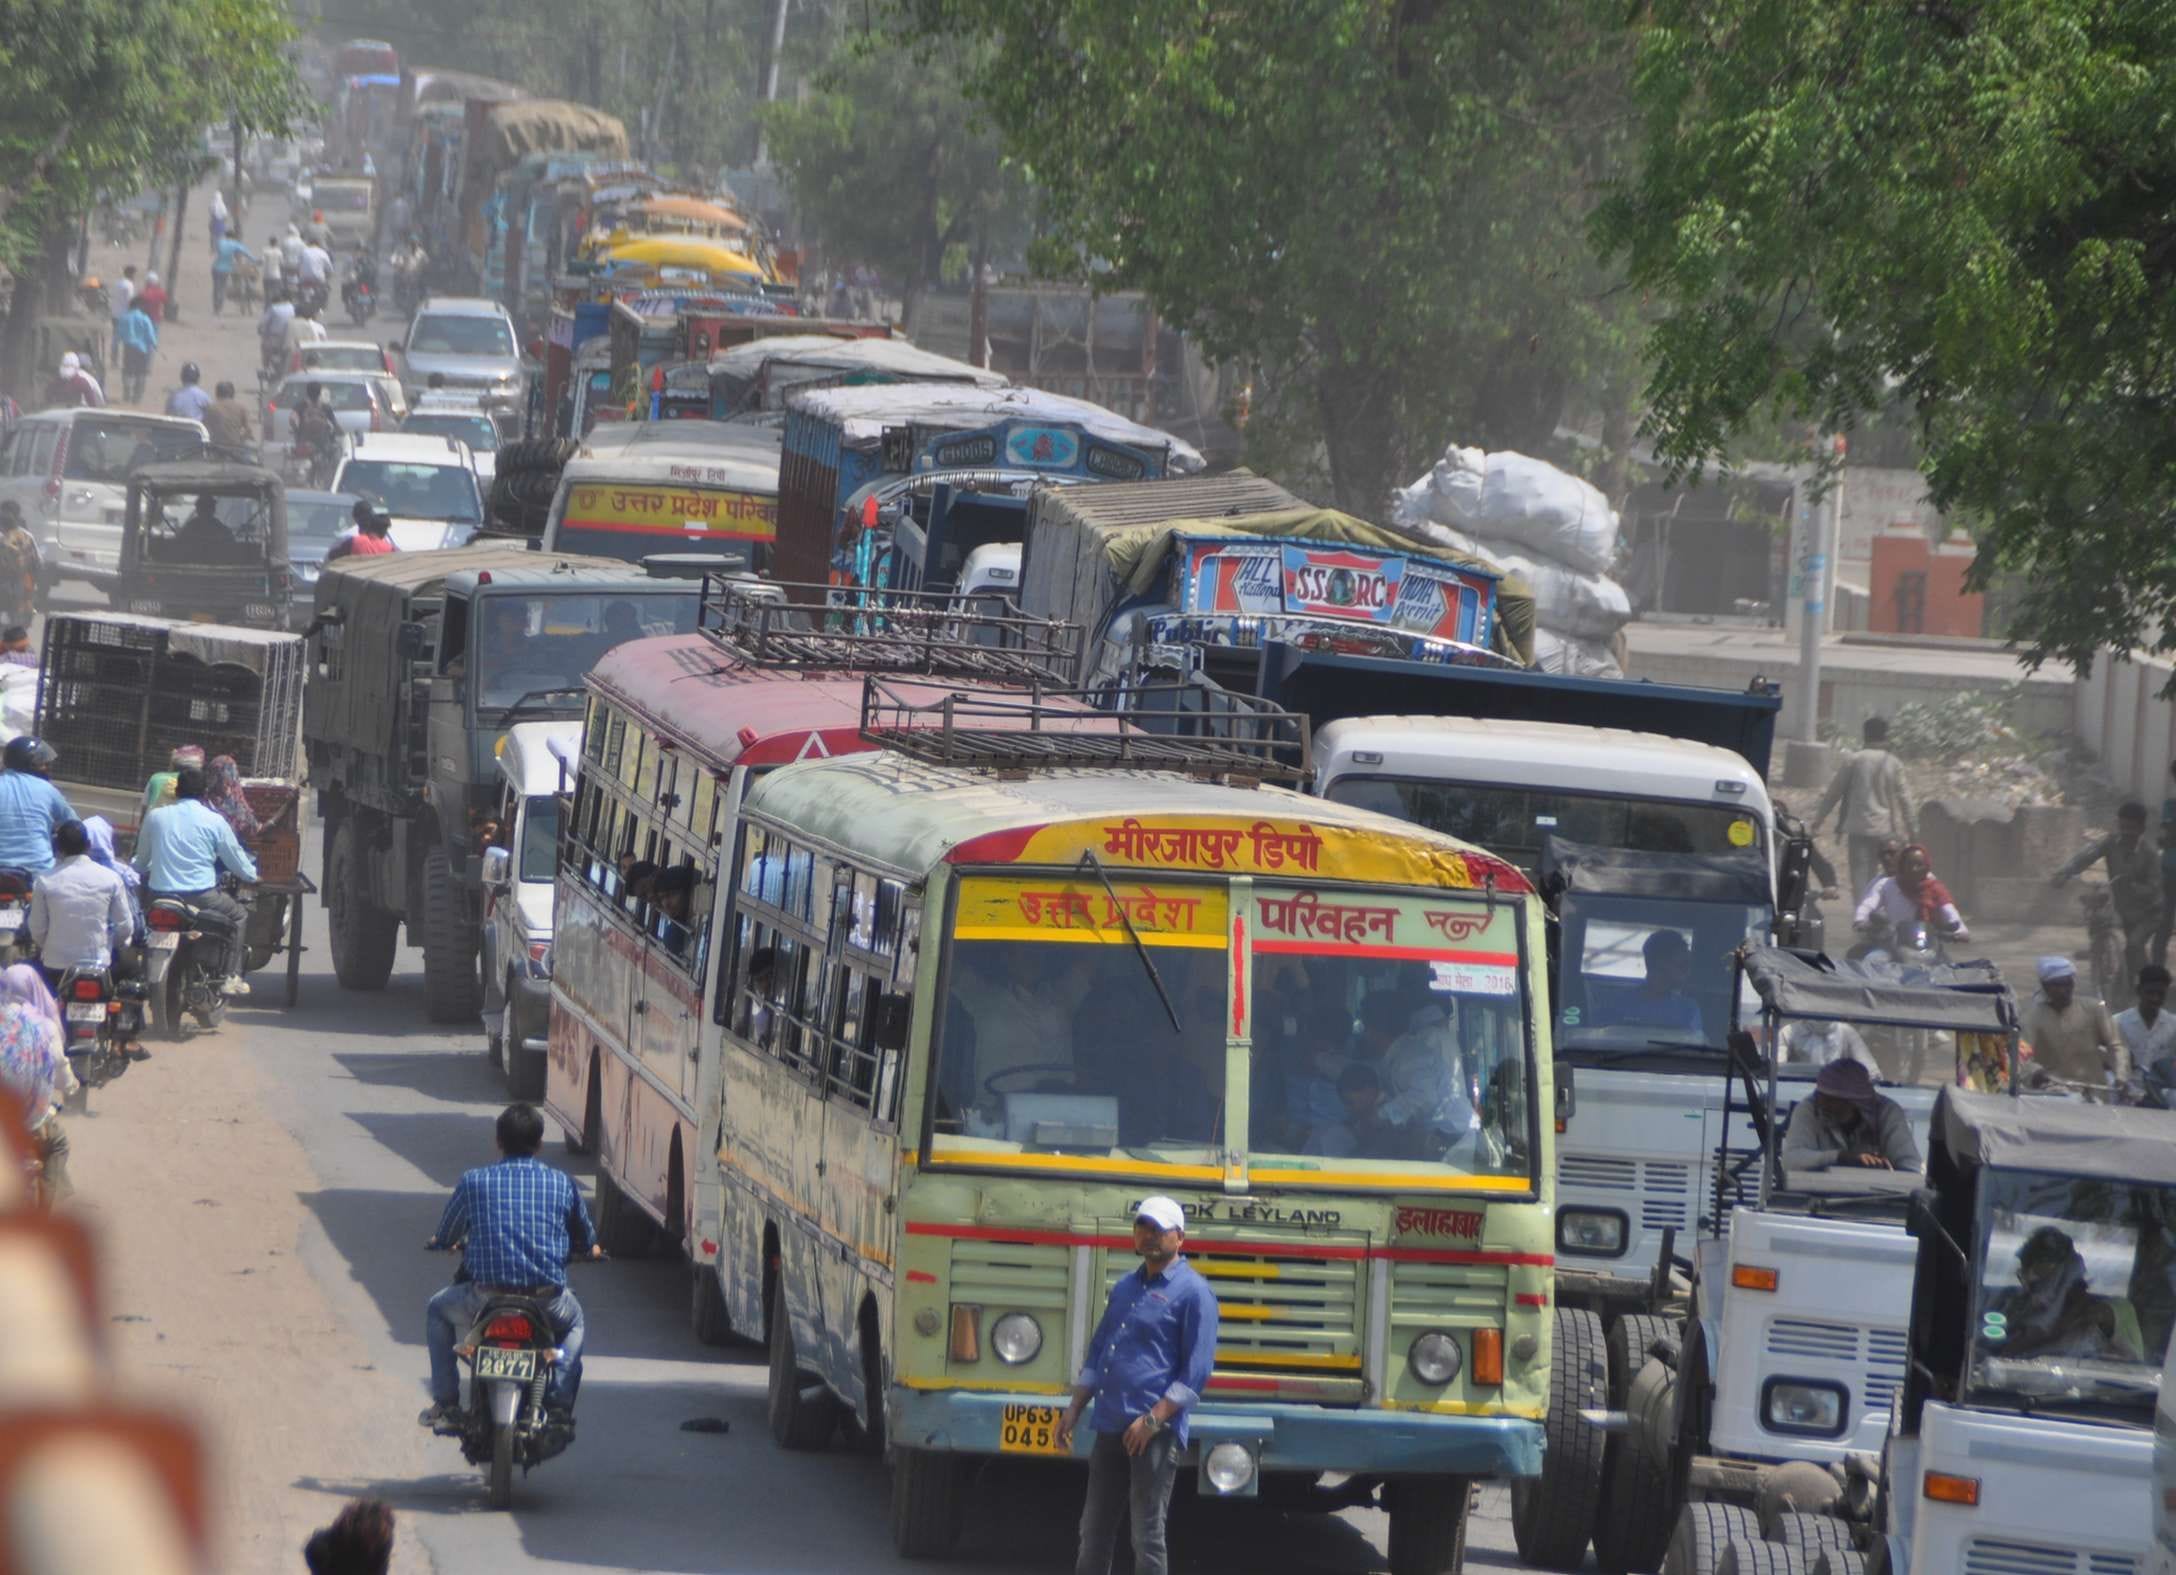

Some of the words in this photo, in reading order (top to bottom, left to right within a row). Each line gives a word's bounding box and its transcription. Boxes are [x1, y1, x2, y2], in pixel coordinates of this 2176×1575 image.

[611, 490, 664, 513] उत्तर
[671, 490, 719, 518] प्रदेश
[1239, 557, 1274, 583] ALL
[1399, 574, 1436, 605] INDIA
[1104, 817, 1244, 869] मीरजापुर
[1249, 821, 1322, 871] डिपो
[1018, 890, 1094, 927] उत्तर
[1102, 887, 1202, 931] प्रदेश
[1256, 890, 1400, 945] परिवहन
[1229, 1206, 1341, 1224] LEYLAND
[1004, 1425, 1060, 1448] 045
